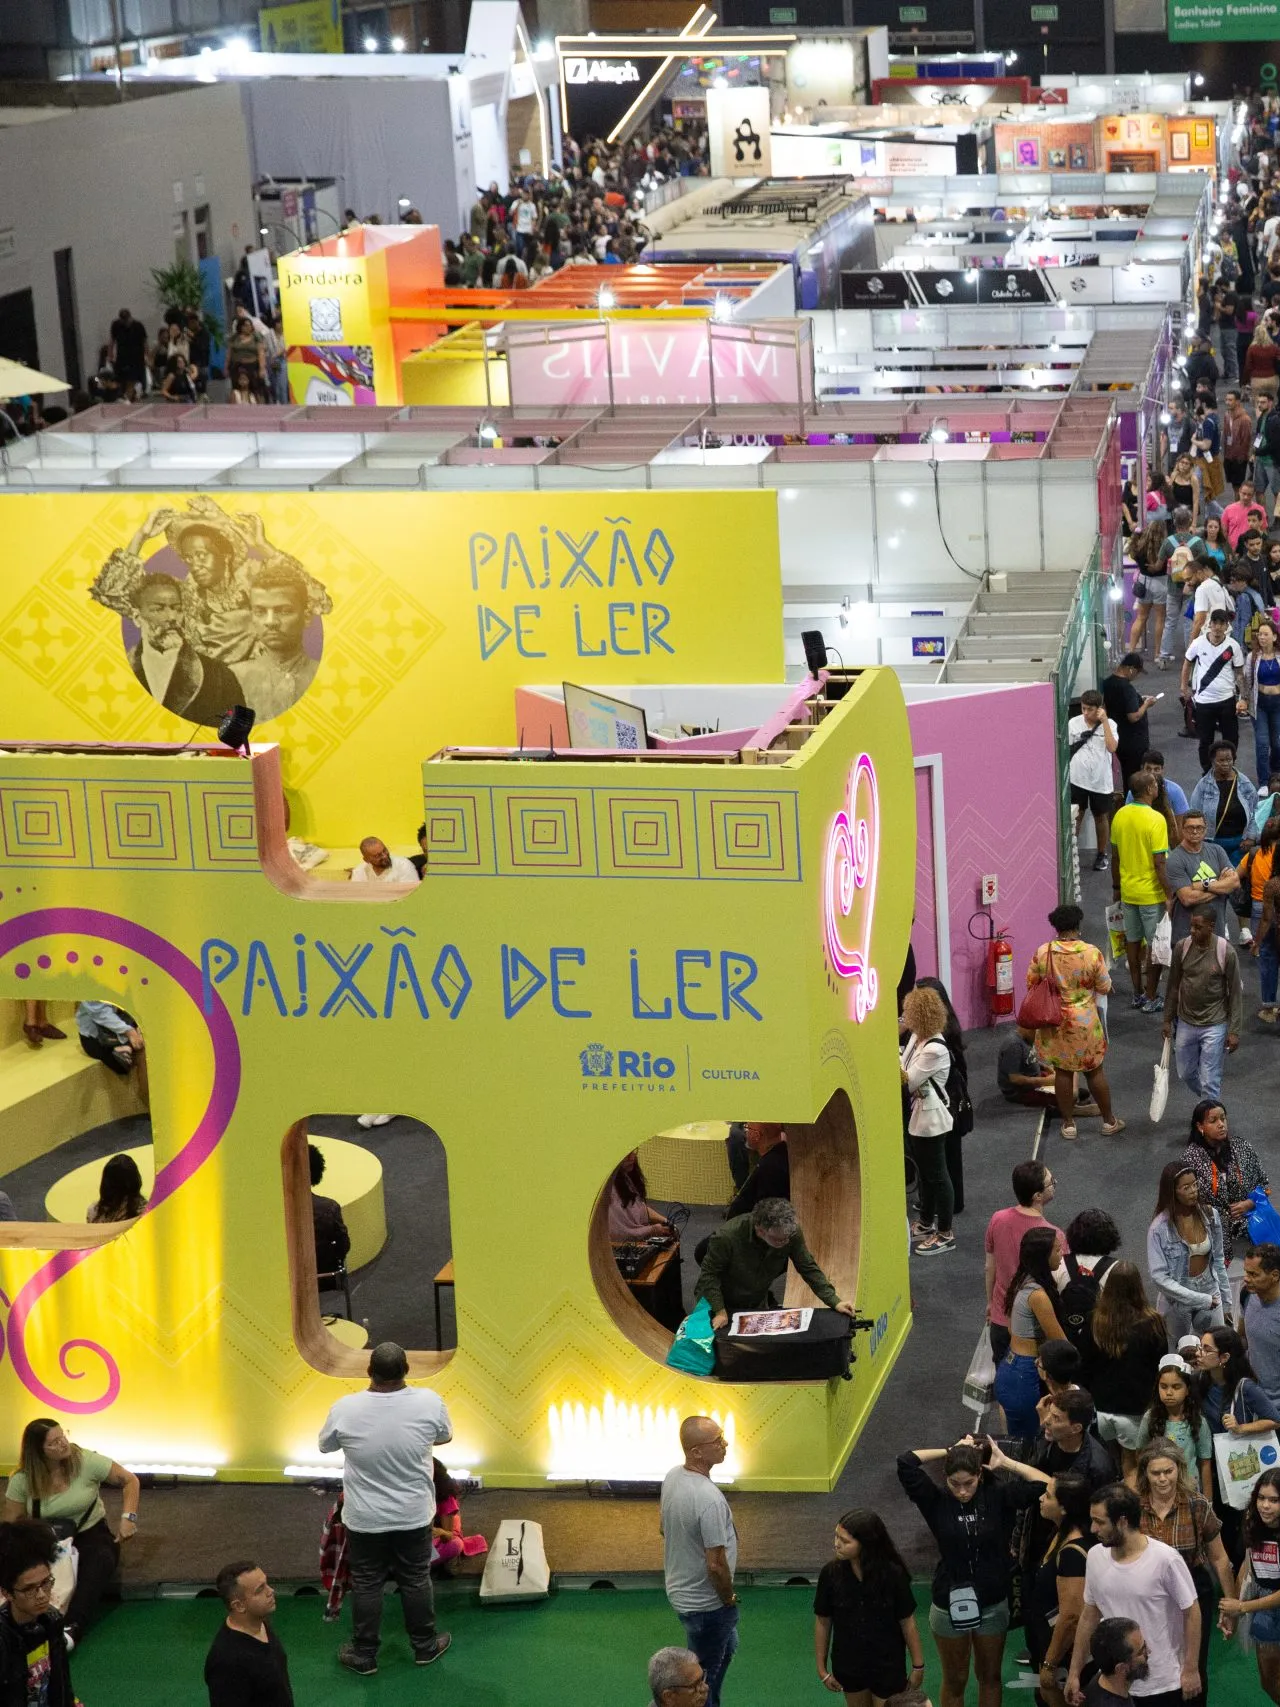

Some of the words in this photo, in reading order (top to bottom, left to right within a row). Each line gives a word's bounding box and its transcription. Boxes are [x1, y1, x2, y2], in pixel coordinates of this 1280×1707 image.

[1174, 5, 1224, 17] Banheiro
[1226, 3, 1278, 15] Feminino
[469, 516, 675, 591] PAIXÃO
[477, 604, 547, 661] DE
[573, 601, 676, 657] LER
[200, 926, 474, 1019] PAIXÃO
[500, 943, 593, 1020] DE
[630, 948, 764, 1021] LER
[618, 1051, 676, 1079] Rio
[702, 1069, 761, 1081] CULTURA
[582, 1083, 676, 1092] PREFEITURA
